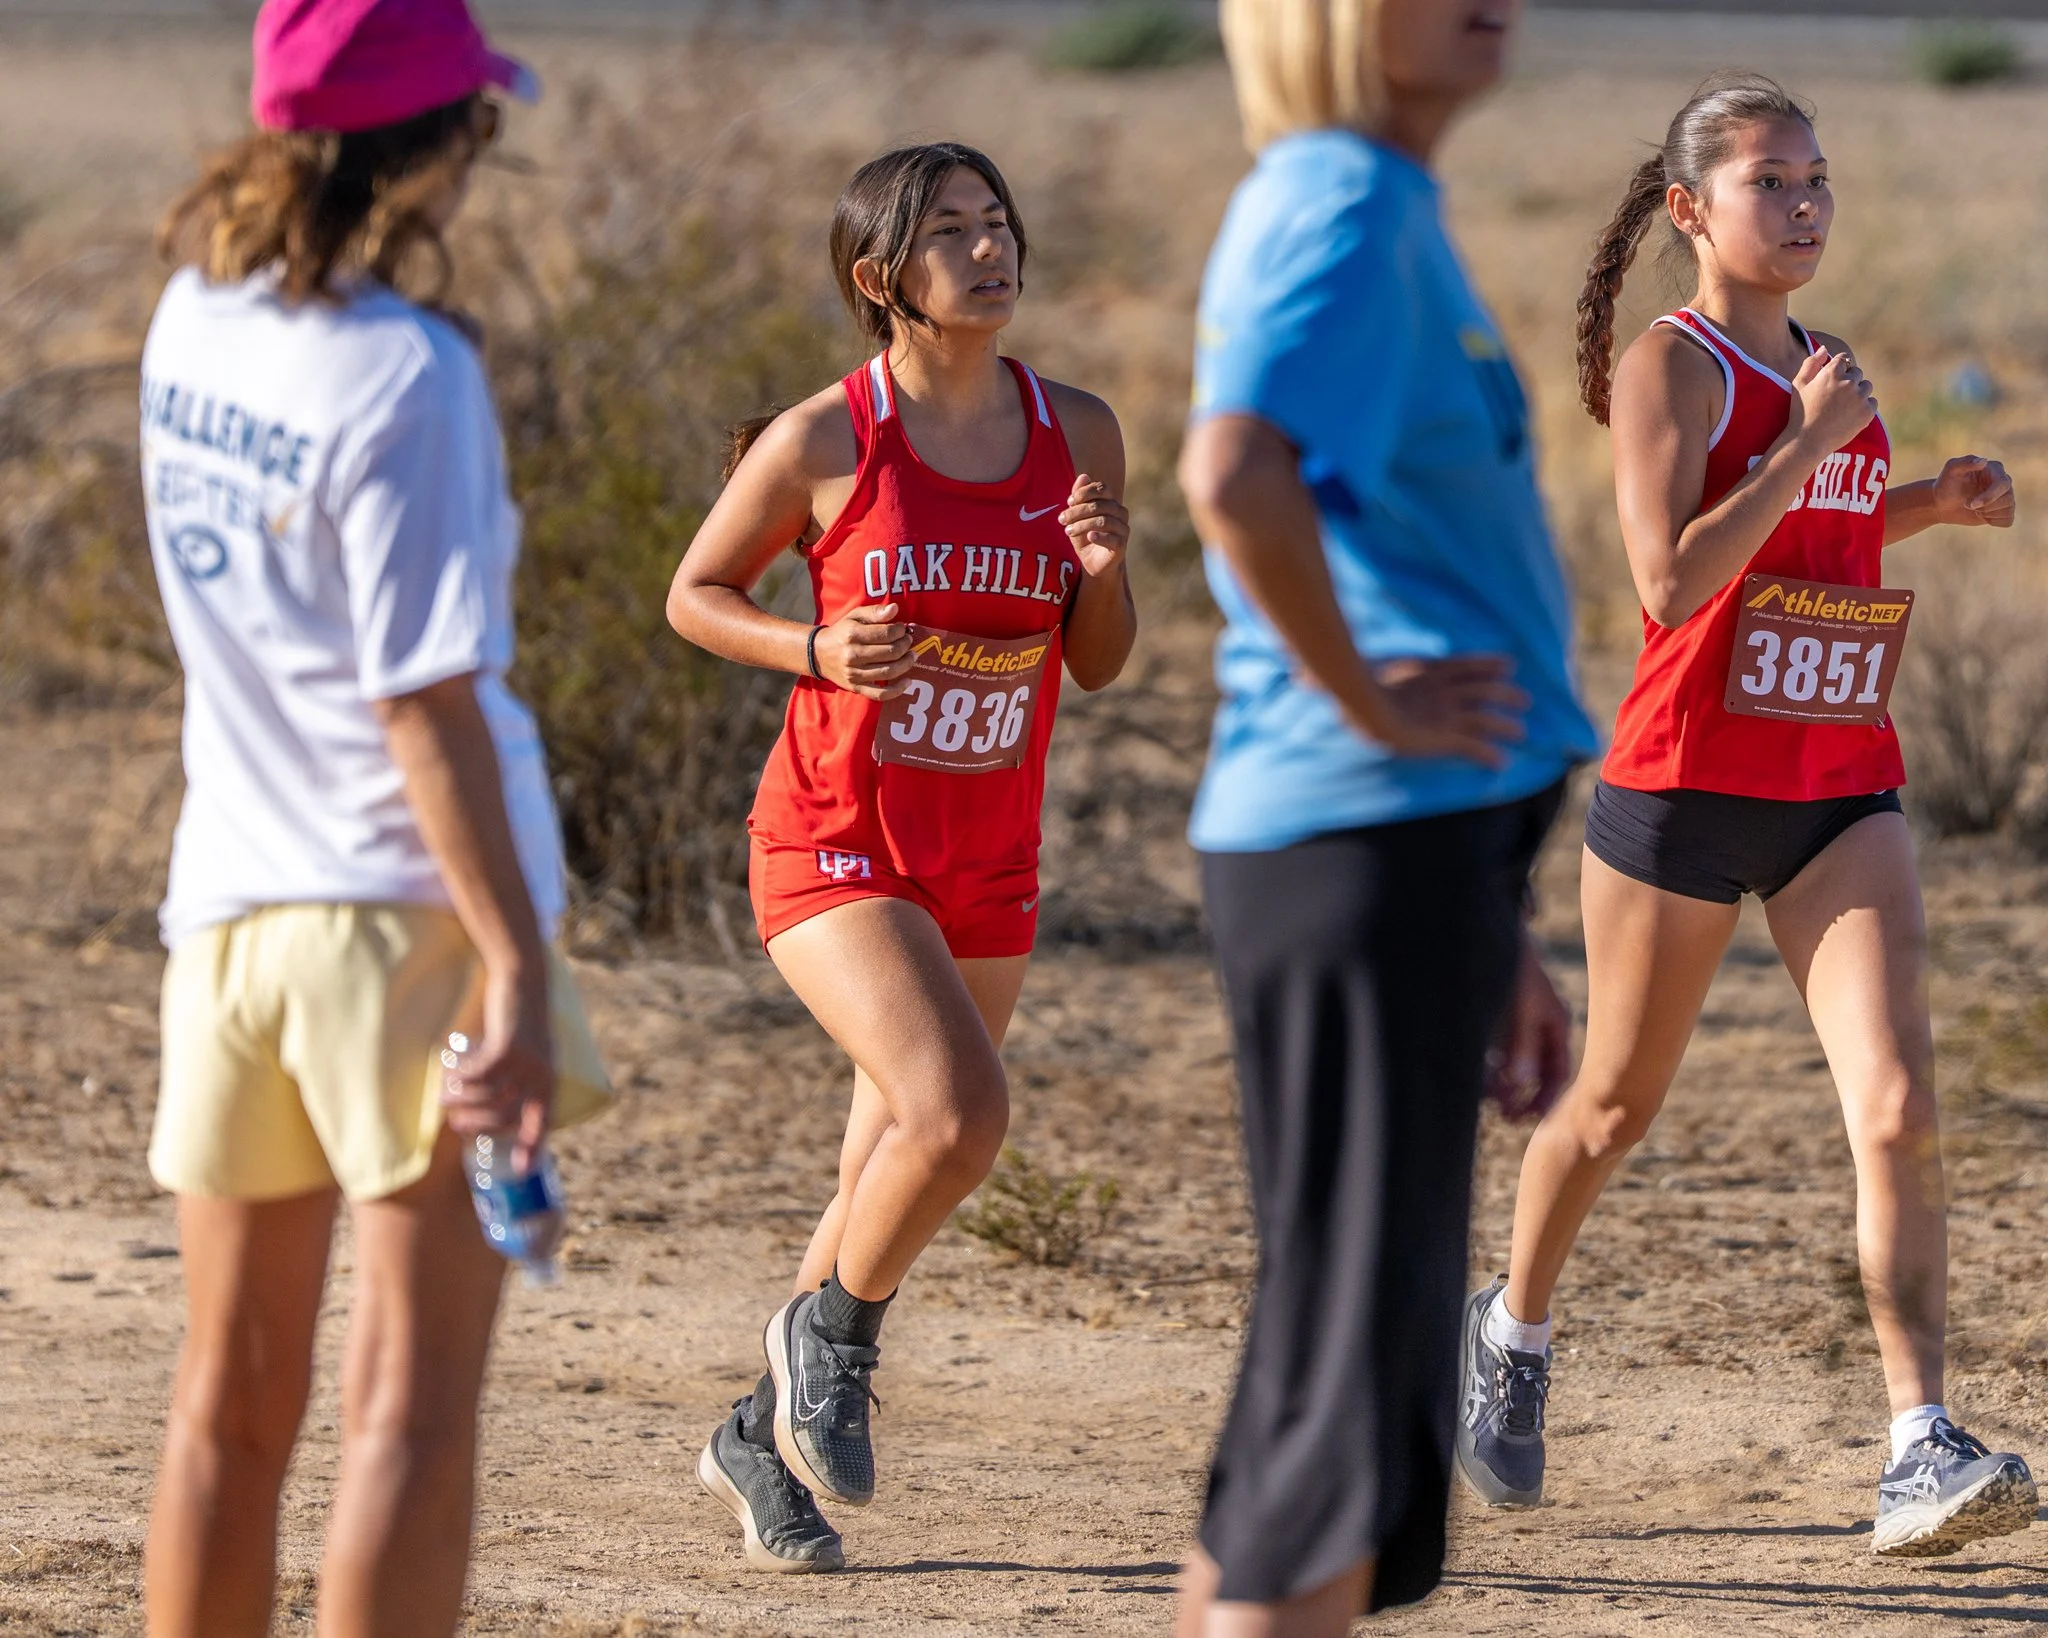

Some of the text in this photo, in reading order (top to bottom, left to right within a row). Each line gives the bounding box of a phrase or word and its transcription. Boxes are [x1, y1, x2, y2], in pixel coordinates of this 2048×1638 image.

[1807, 452, 1888, 516] HILLS
[864, 544, 1075, 606] OAK HILLS
[1741, 629, 1886, 705] 3851
[889, 679, 1030, 754] 3836
